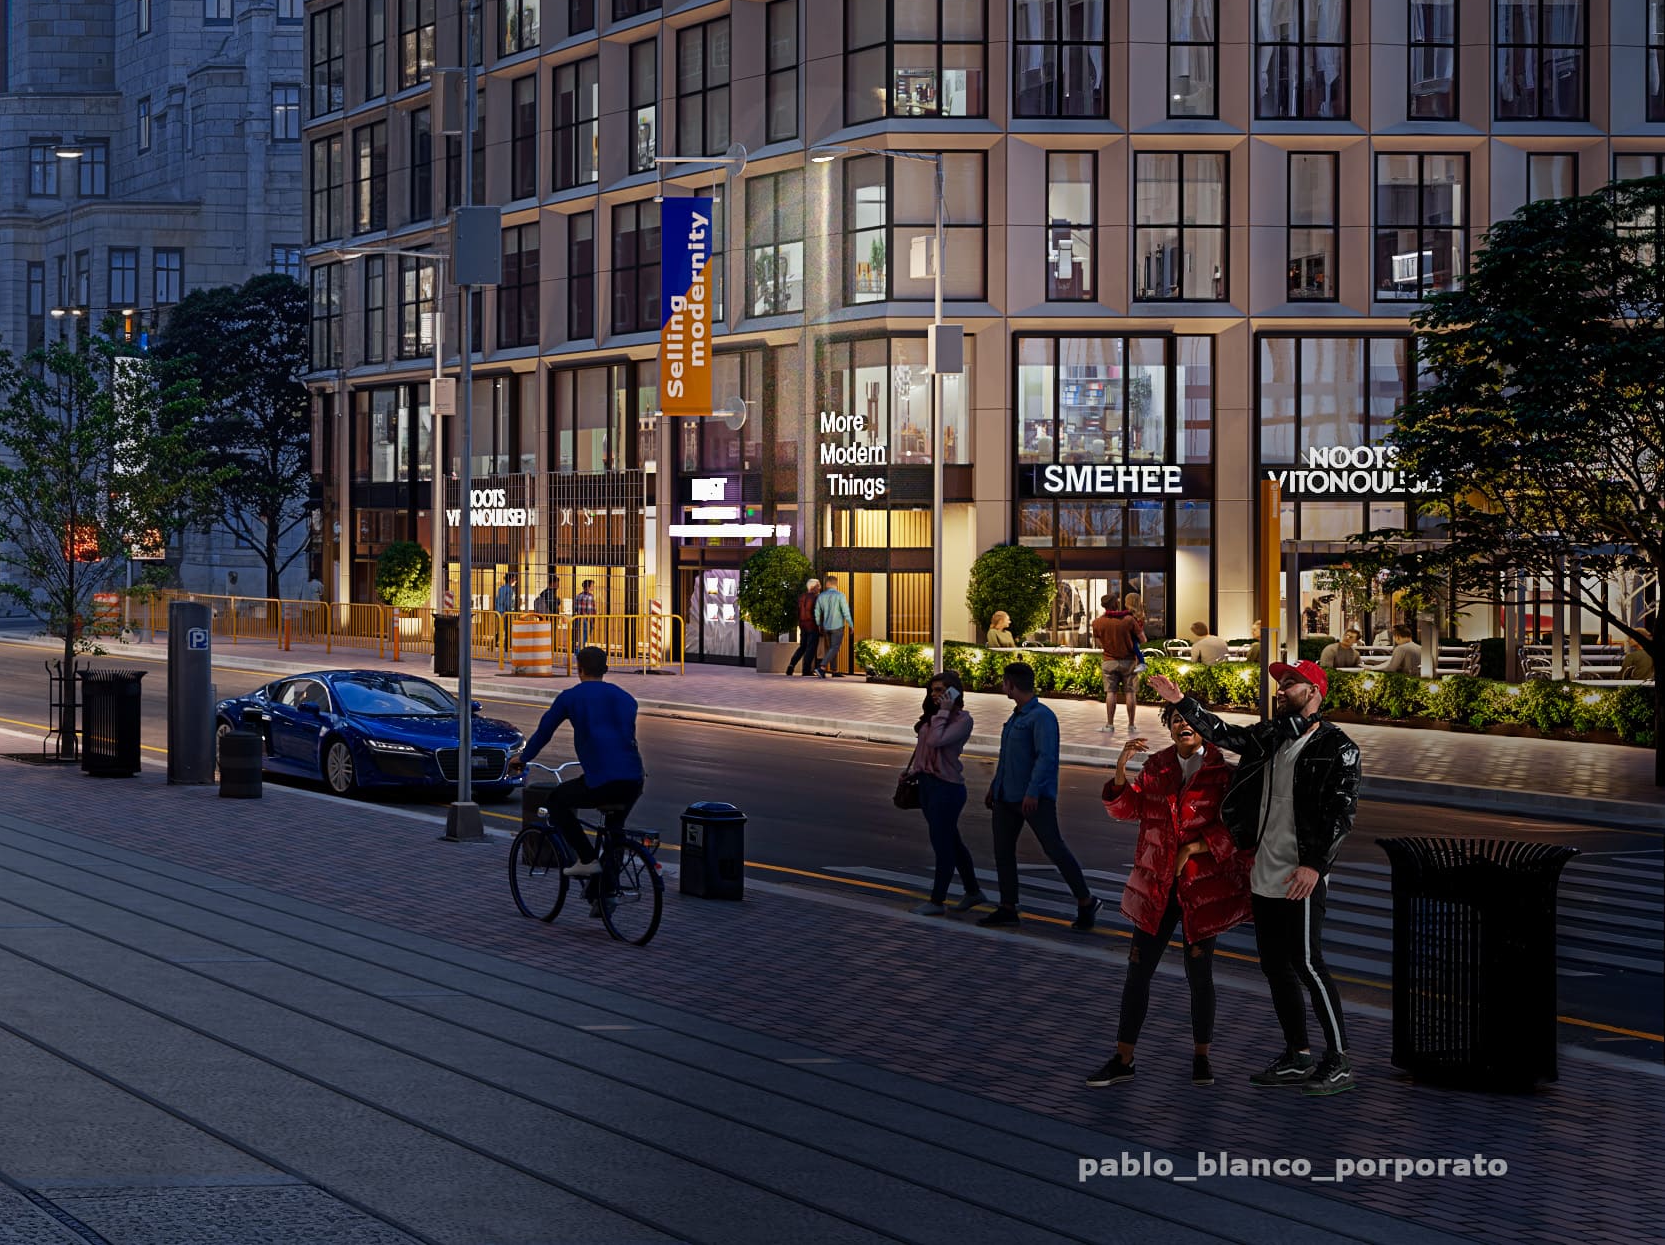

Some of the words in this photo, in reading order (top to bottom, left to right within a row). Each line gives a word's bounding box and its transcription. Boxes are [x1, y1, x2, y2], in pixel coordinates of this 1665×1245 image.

[688, 211, 709, 367] modernity
[667, 295, 688, 398] Selling
[820, 411, 864, 434] More
[820, 442, 886, 465] Modern
[826, 473, 886, 501] Things
[192, 632, 205, 648] P
